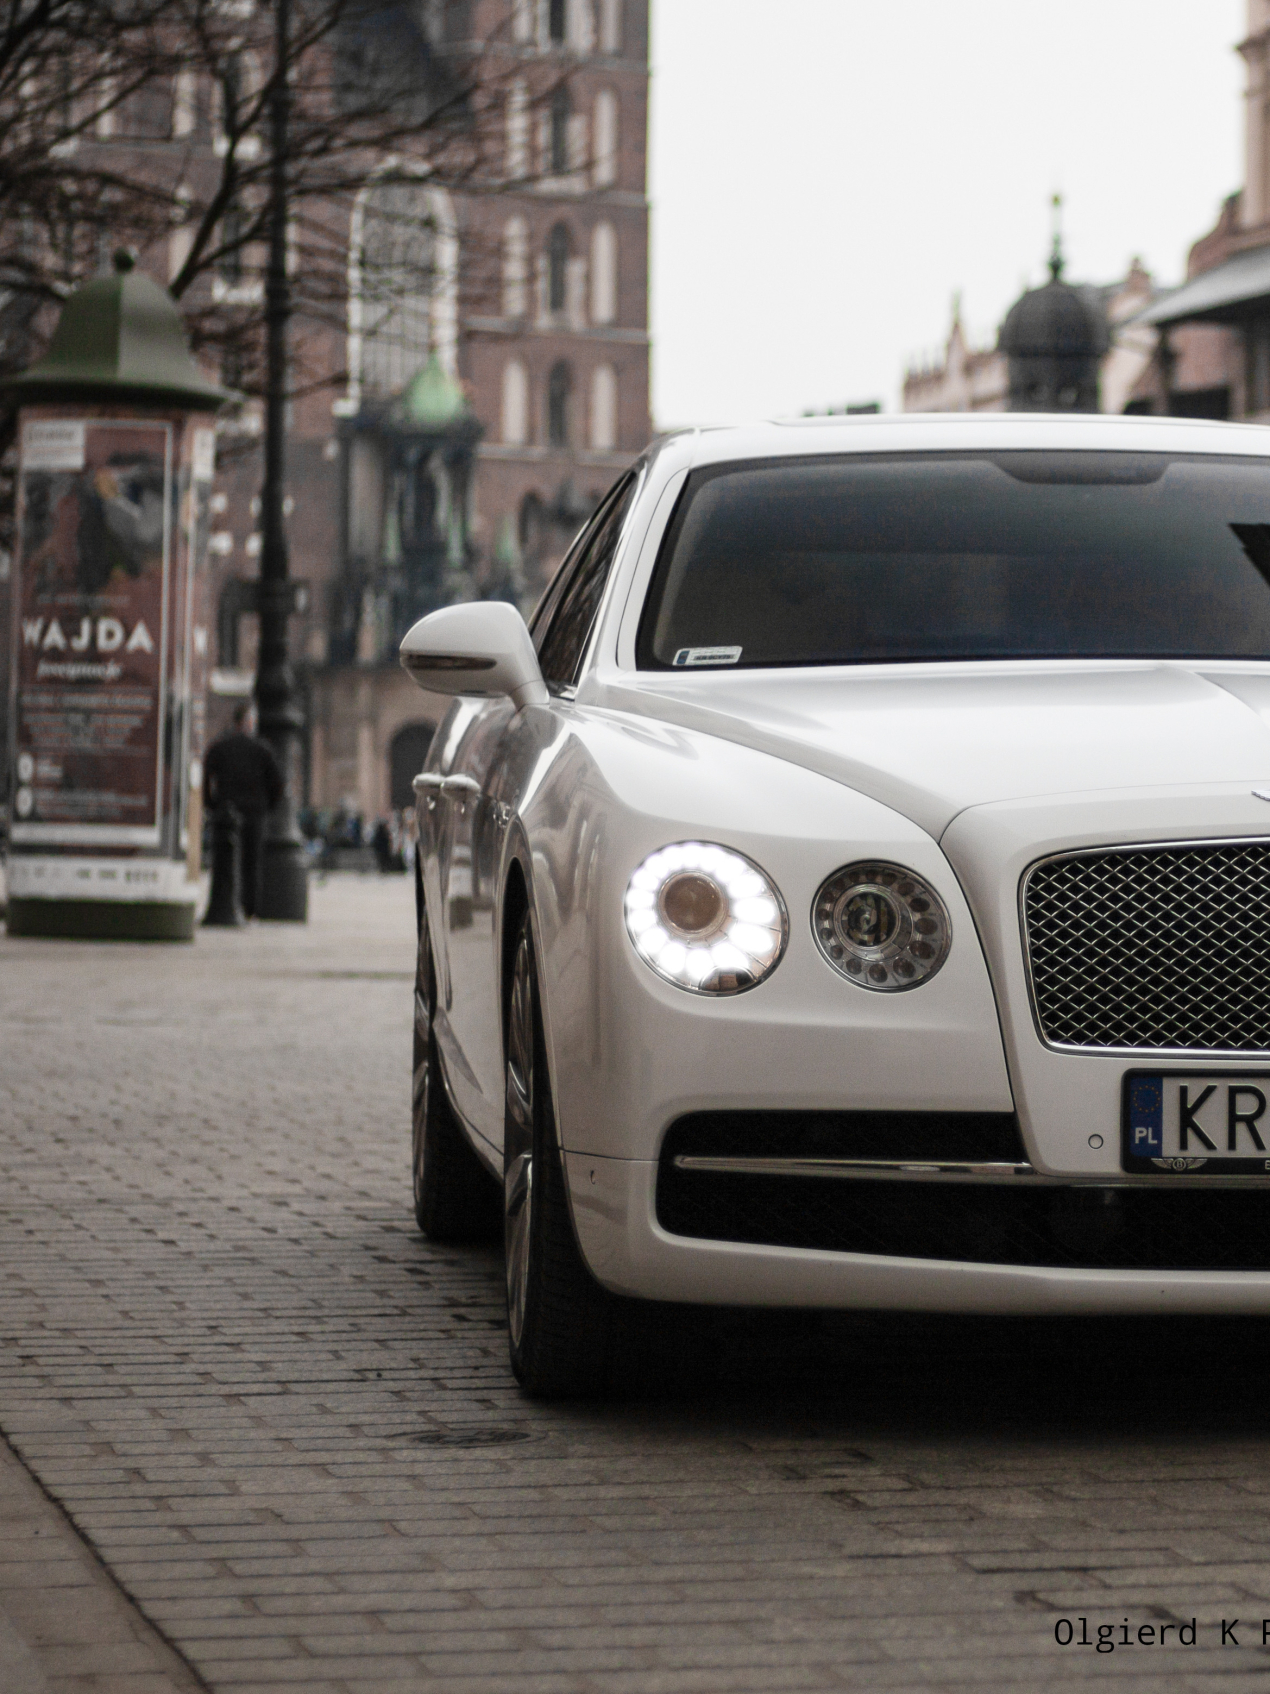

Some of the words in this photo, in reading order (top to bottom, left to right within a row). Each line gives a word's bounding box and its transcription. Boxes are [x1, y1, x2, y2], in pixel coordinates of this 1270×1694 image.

[22, 616, 153, 653] WAJDA
[1134, 1127, 1158, 1145] PL
[1179, 1084, 1267, 1151] KR
